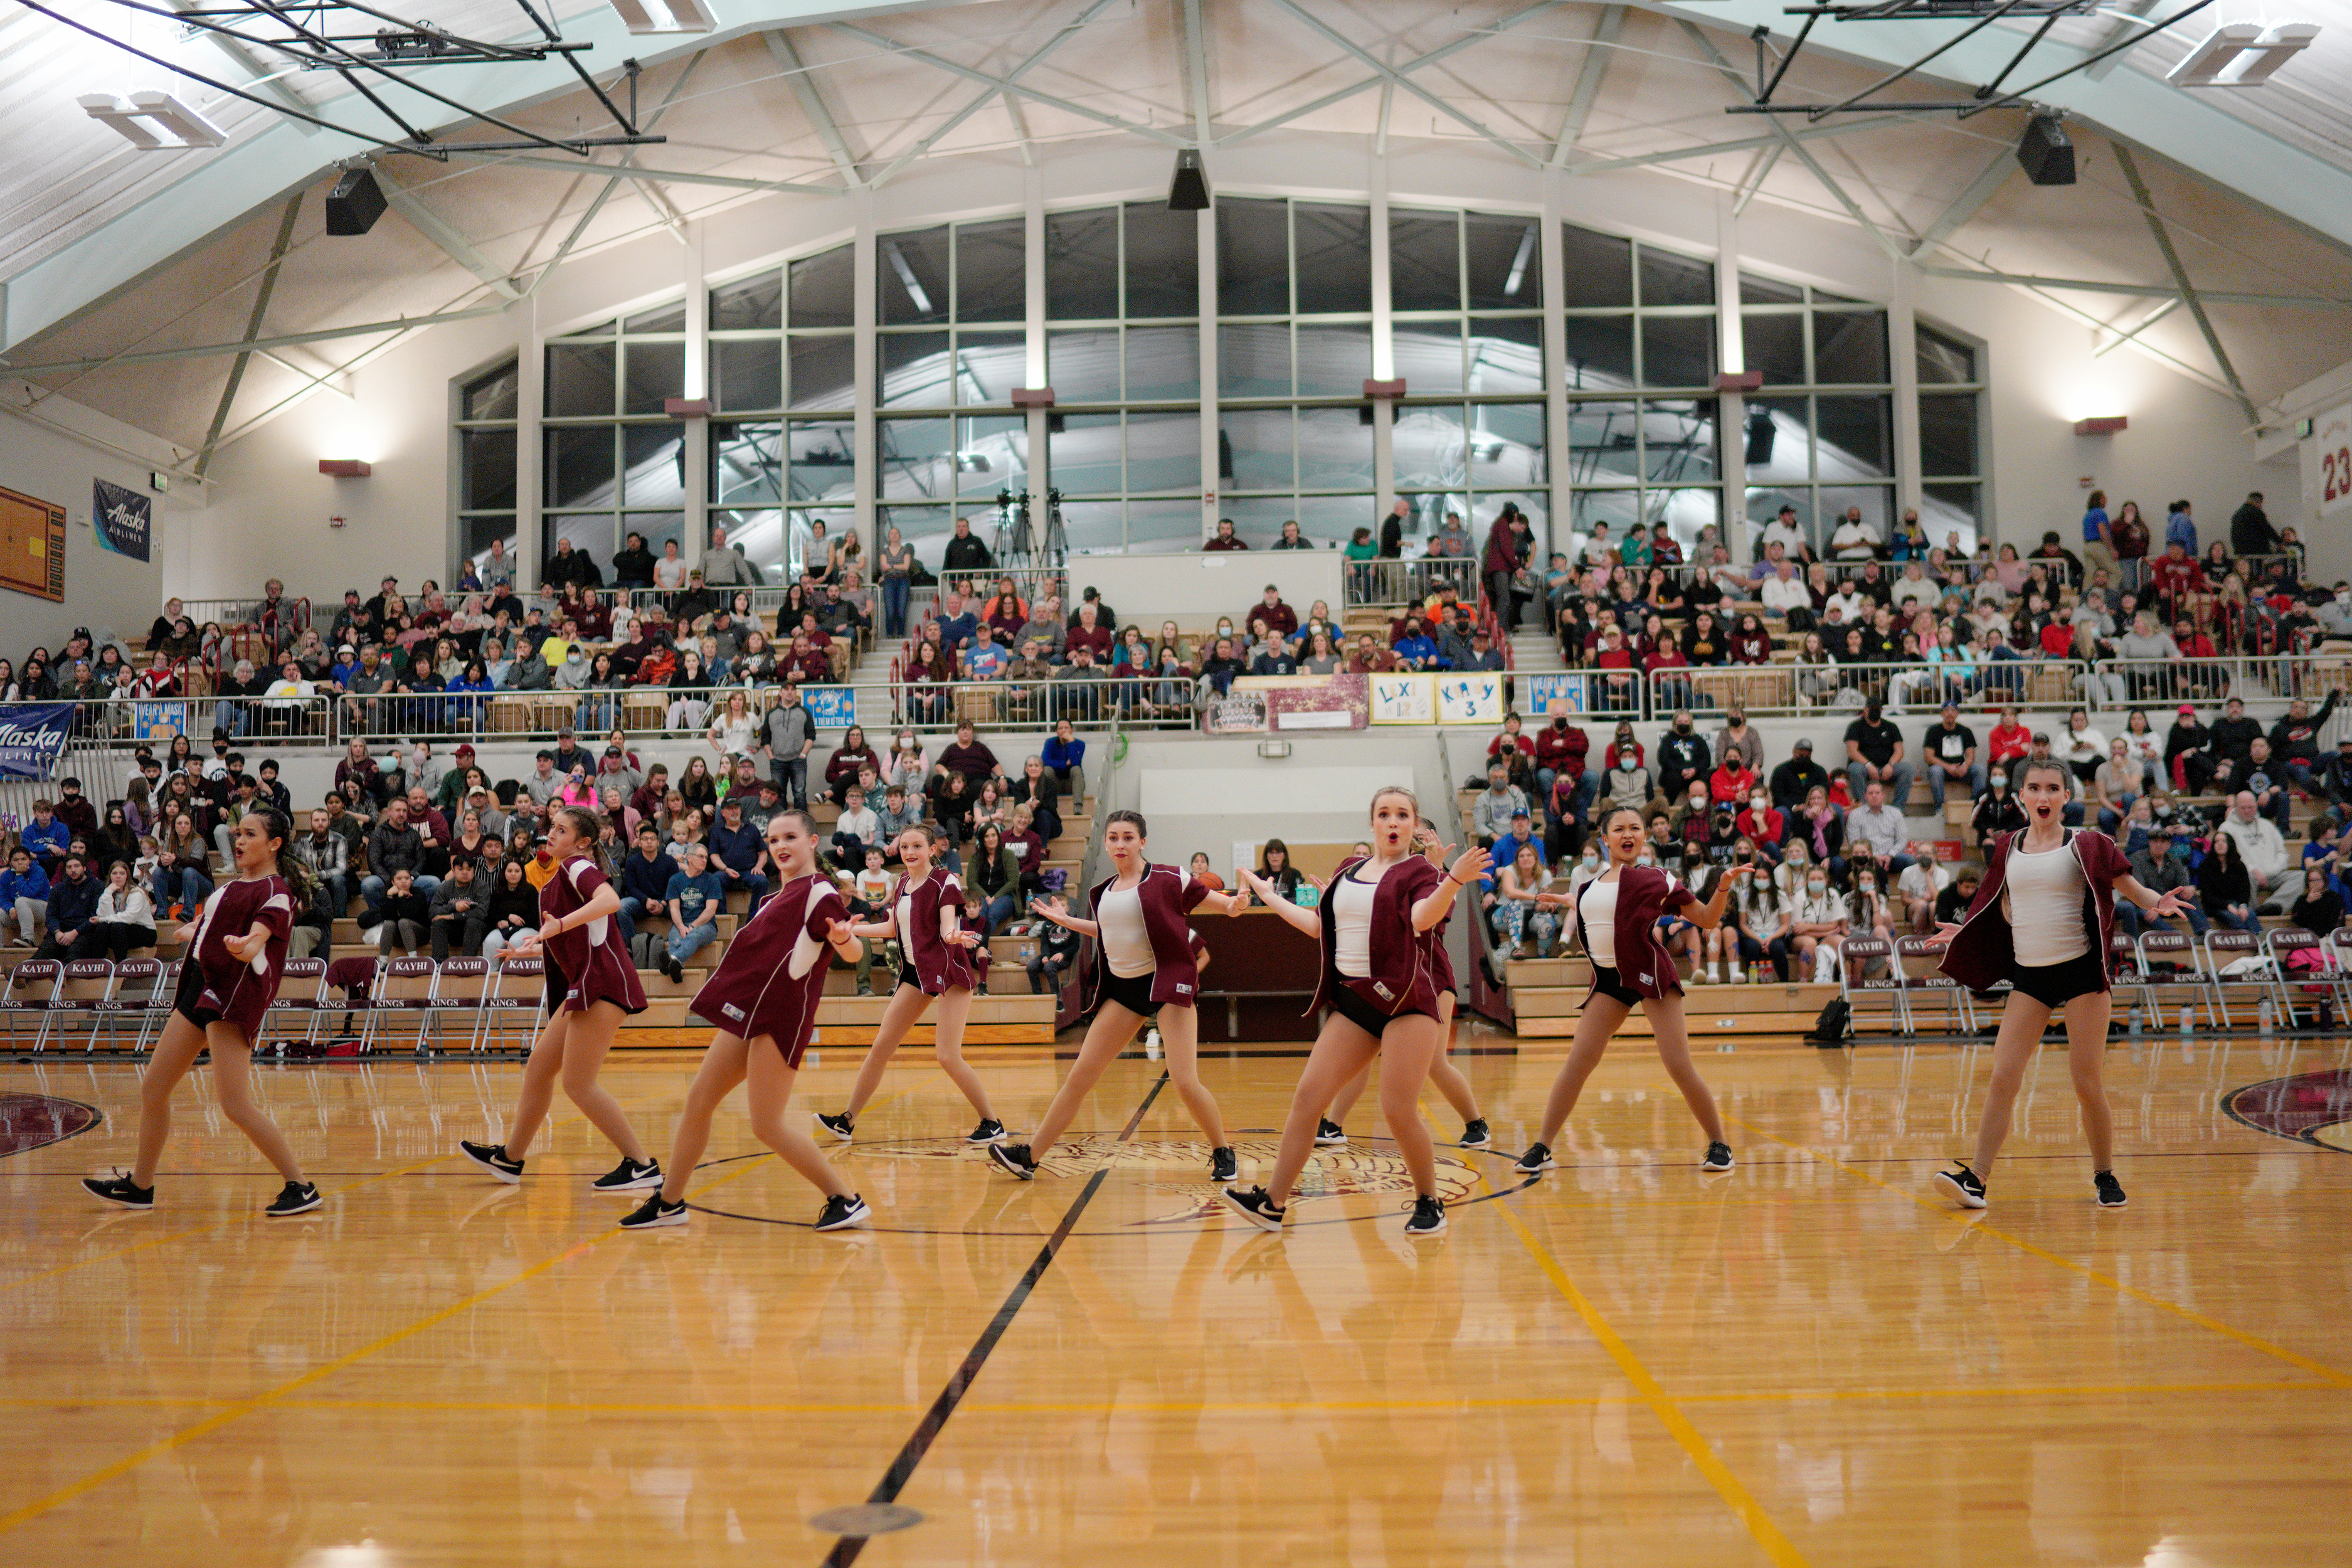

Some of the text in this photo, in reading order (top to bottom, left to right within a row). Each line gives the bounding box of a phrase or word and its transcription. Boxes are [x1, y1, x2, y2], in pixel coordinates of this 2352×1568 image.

[2322, 446, 2350, 502] 23
[107, 502, 146, 532] Alaska
[109, 526, 142, 543] AIRLINES
[1379, 681, 1416, 704] LEXI
[139, 702, 158, 716] WEAR
[164, 702, 183, 716] MASK
[2148, 935, 2185, 946] KAYHI
[2215, 935, 2250, 945] KAYHI
[2276, 933, 2313, 943] KAYHI
[1848, 941, 1883, 951] KAYHI
[21, 964, 53, 973] KAYHI
[72, 963, 105, 972] KAYHI
[122, 963, 153, 972] KAYHI
[285, 962, 318, 971] KAYHI
[395, 961, 427, 970] KAYHI
[448, 961, 482, 970] KAYHI
[509, 960, 542, 969] KAYHI
[2115, 975, 2146, 984] KINGS
[2175, 973, 2206, 982] KINGS
[2242, 973, 2274, 982] KINGS
[2309, 972, 2341, 980] KINGS
[1864, 980, 1895, 988] KINGS
[1926, 978, 1956, 987] KINGS
[95, 1002, 122, 1010] KINGS
[148, 999, 174, 1007] KINGS
[318, 1000, 346, 1009] KINGS
[376, 1000, 405, 1008] KINGS
[430, 999, 458, 1007] KINGS
[489, 999, 517, 1007] KINGS
